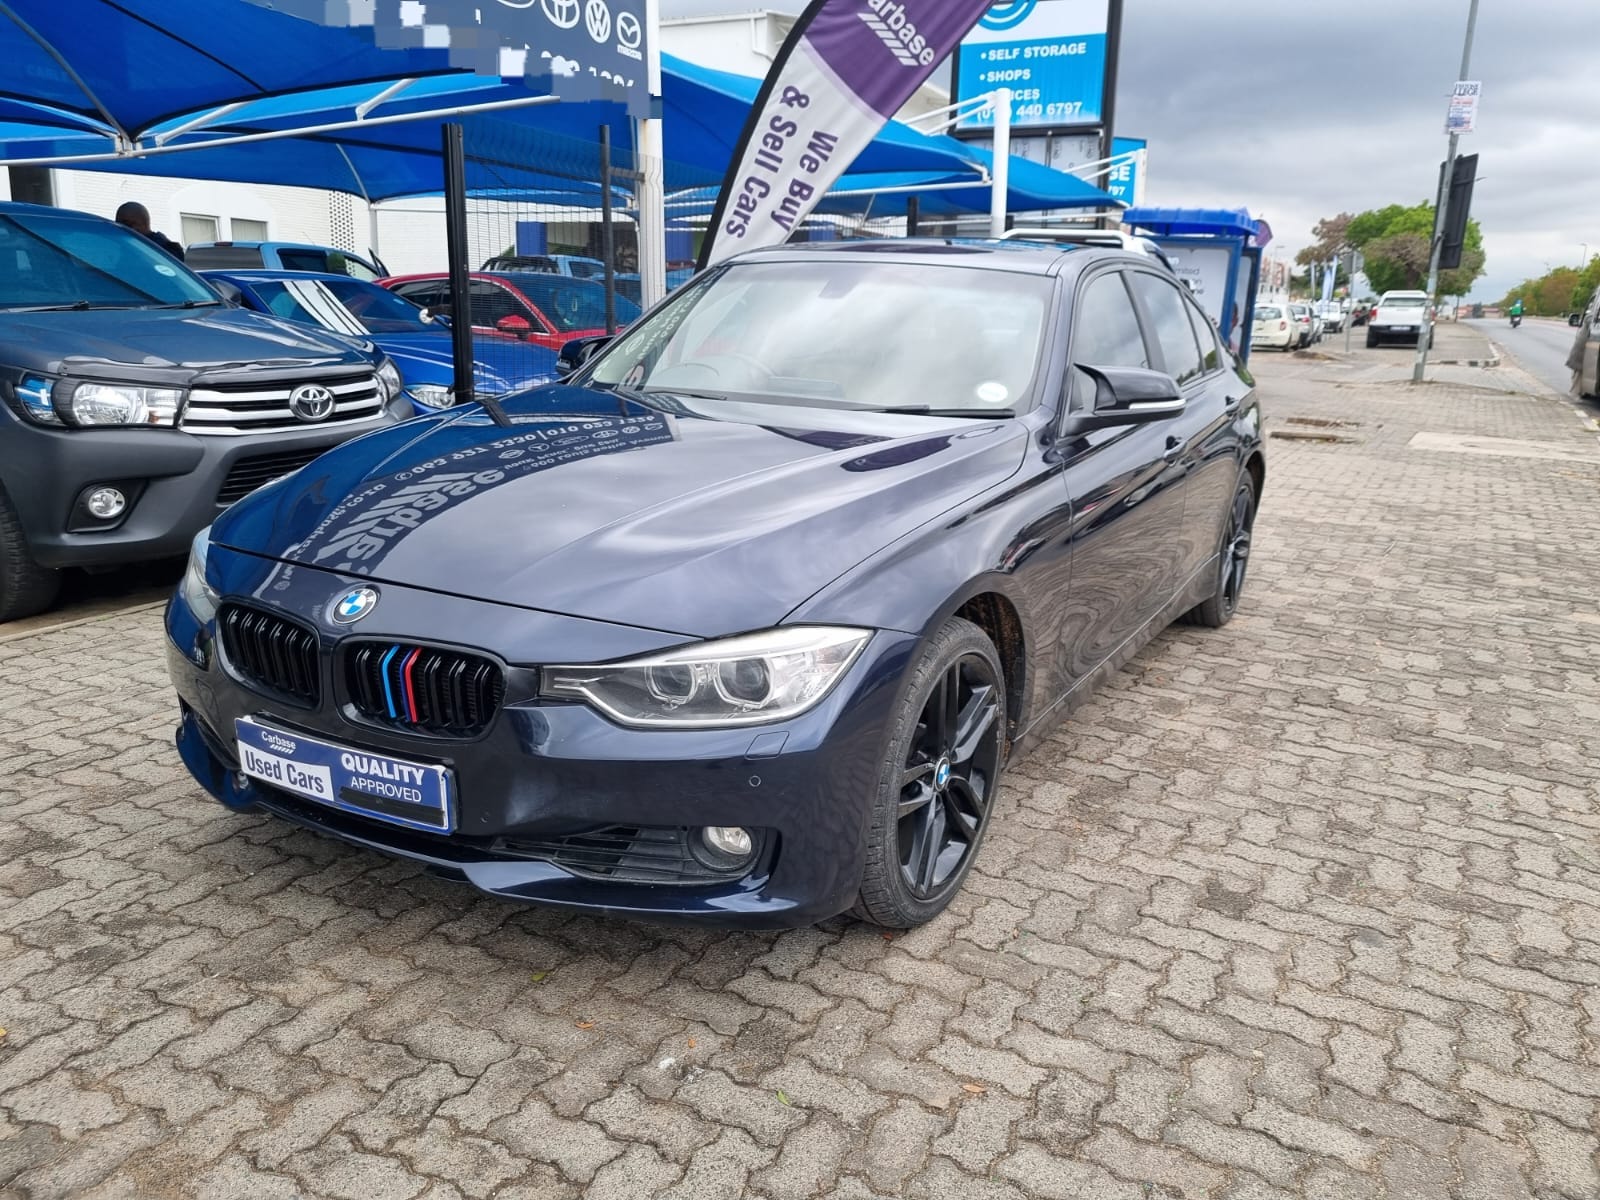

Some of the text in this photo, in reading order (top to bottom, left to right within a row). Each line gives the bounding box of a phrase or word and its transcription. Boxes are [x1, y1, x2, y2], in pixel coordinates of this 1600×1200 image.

[868, 0, 935, 66] arbase
[988, 42, 1087, 61] SELF STORAGE
[987, 69, 1031, 82] SHOPS
[1016, 103, 1043, 116] 440
[1046, 101, 1083, 115] 6797
[725, 85, 810, 239] & Sell Cars
[770, 130, 839, 232] We Buy
[261, 731, 297, 750] Carbase
[245, 750, 325, 794] Used Cars
[341, 753, 425, 786] QUALITY
[350, 776, 422, 802] APPROVED
